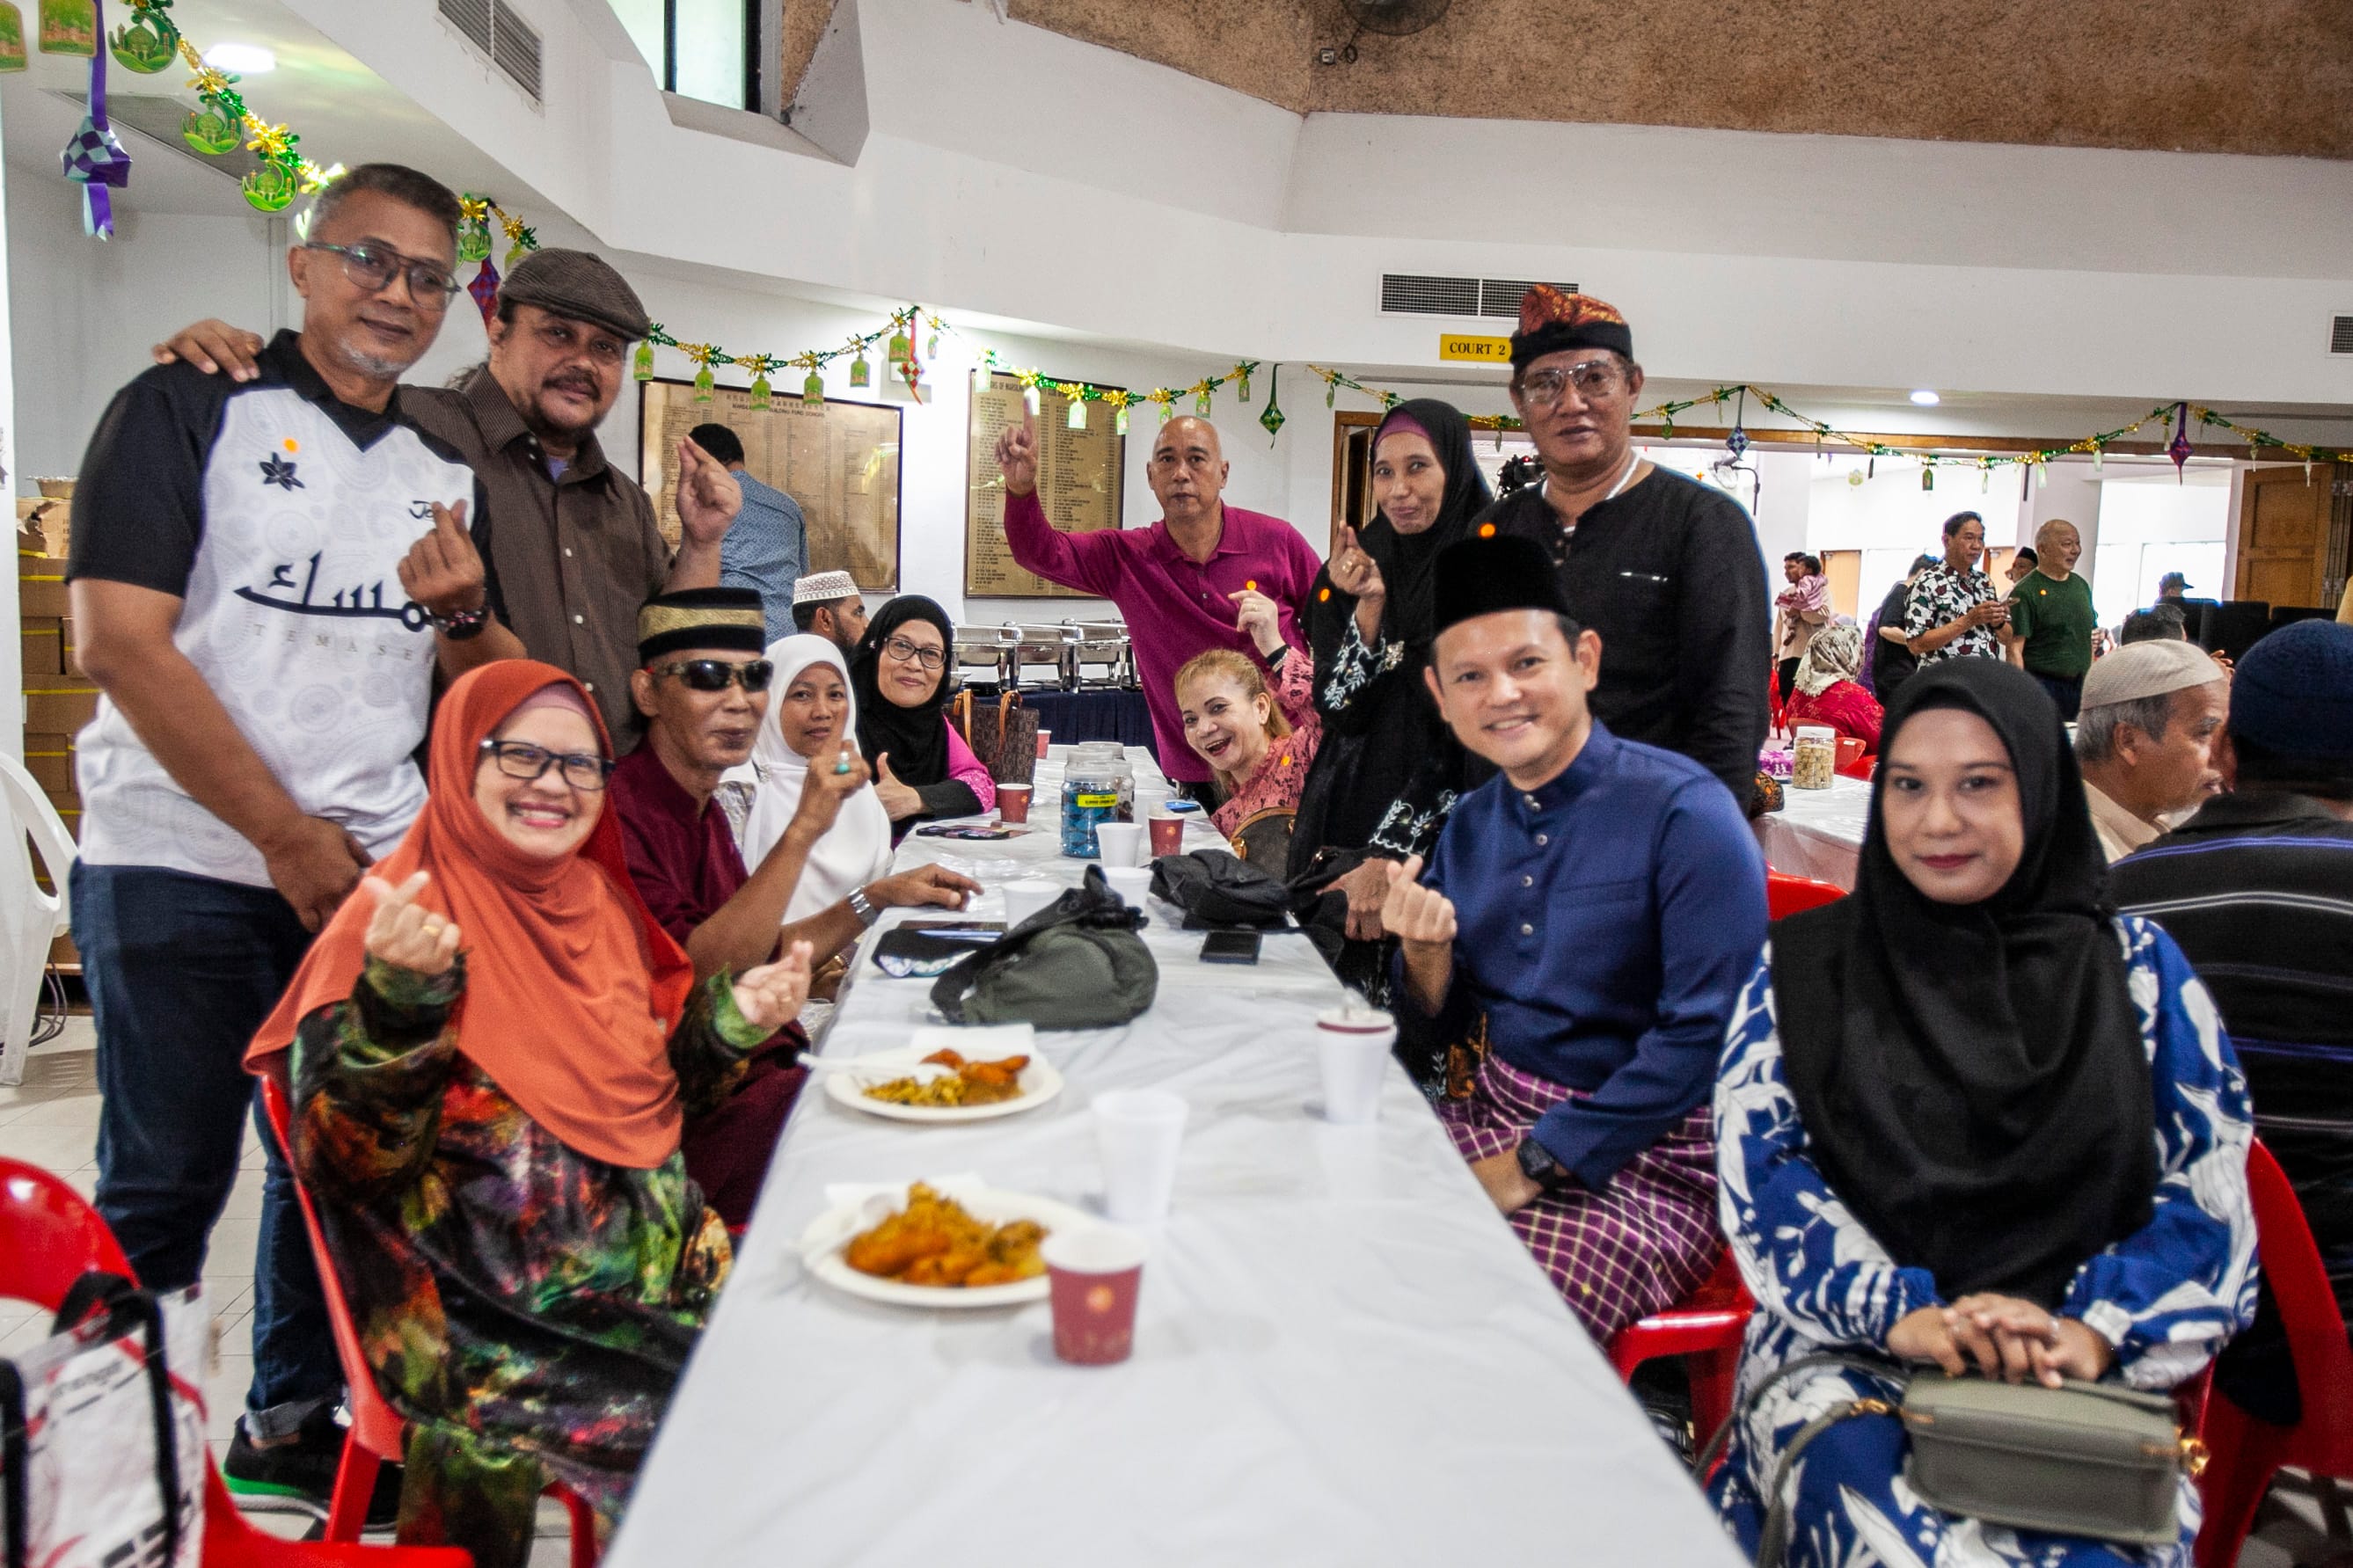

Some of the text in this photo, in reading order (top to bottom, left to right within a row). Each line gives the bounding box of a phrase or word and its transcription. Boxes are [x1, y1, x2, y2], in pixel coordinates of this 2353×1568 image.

[1449, 341, 1506, 356] COURT 2
[252, 623, 432, 662] TEMASE
